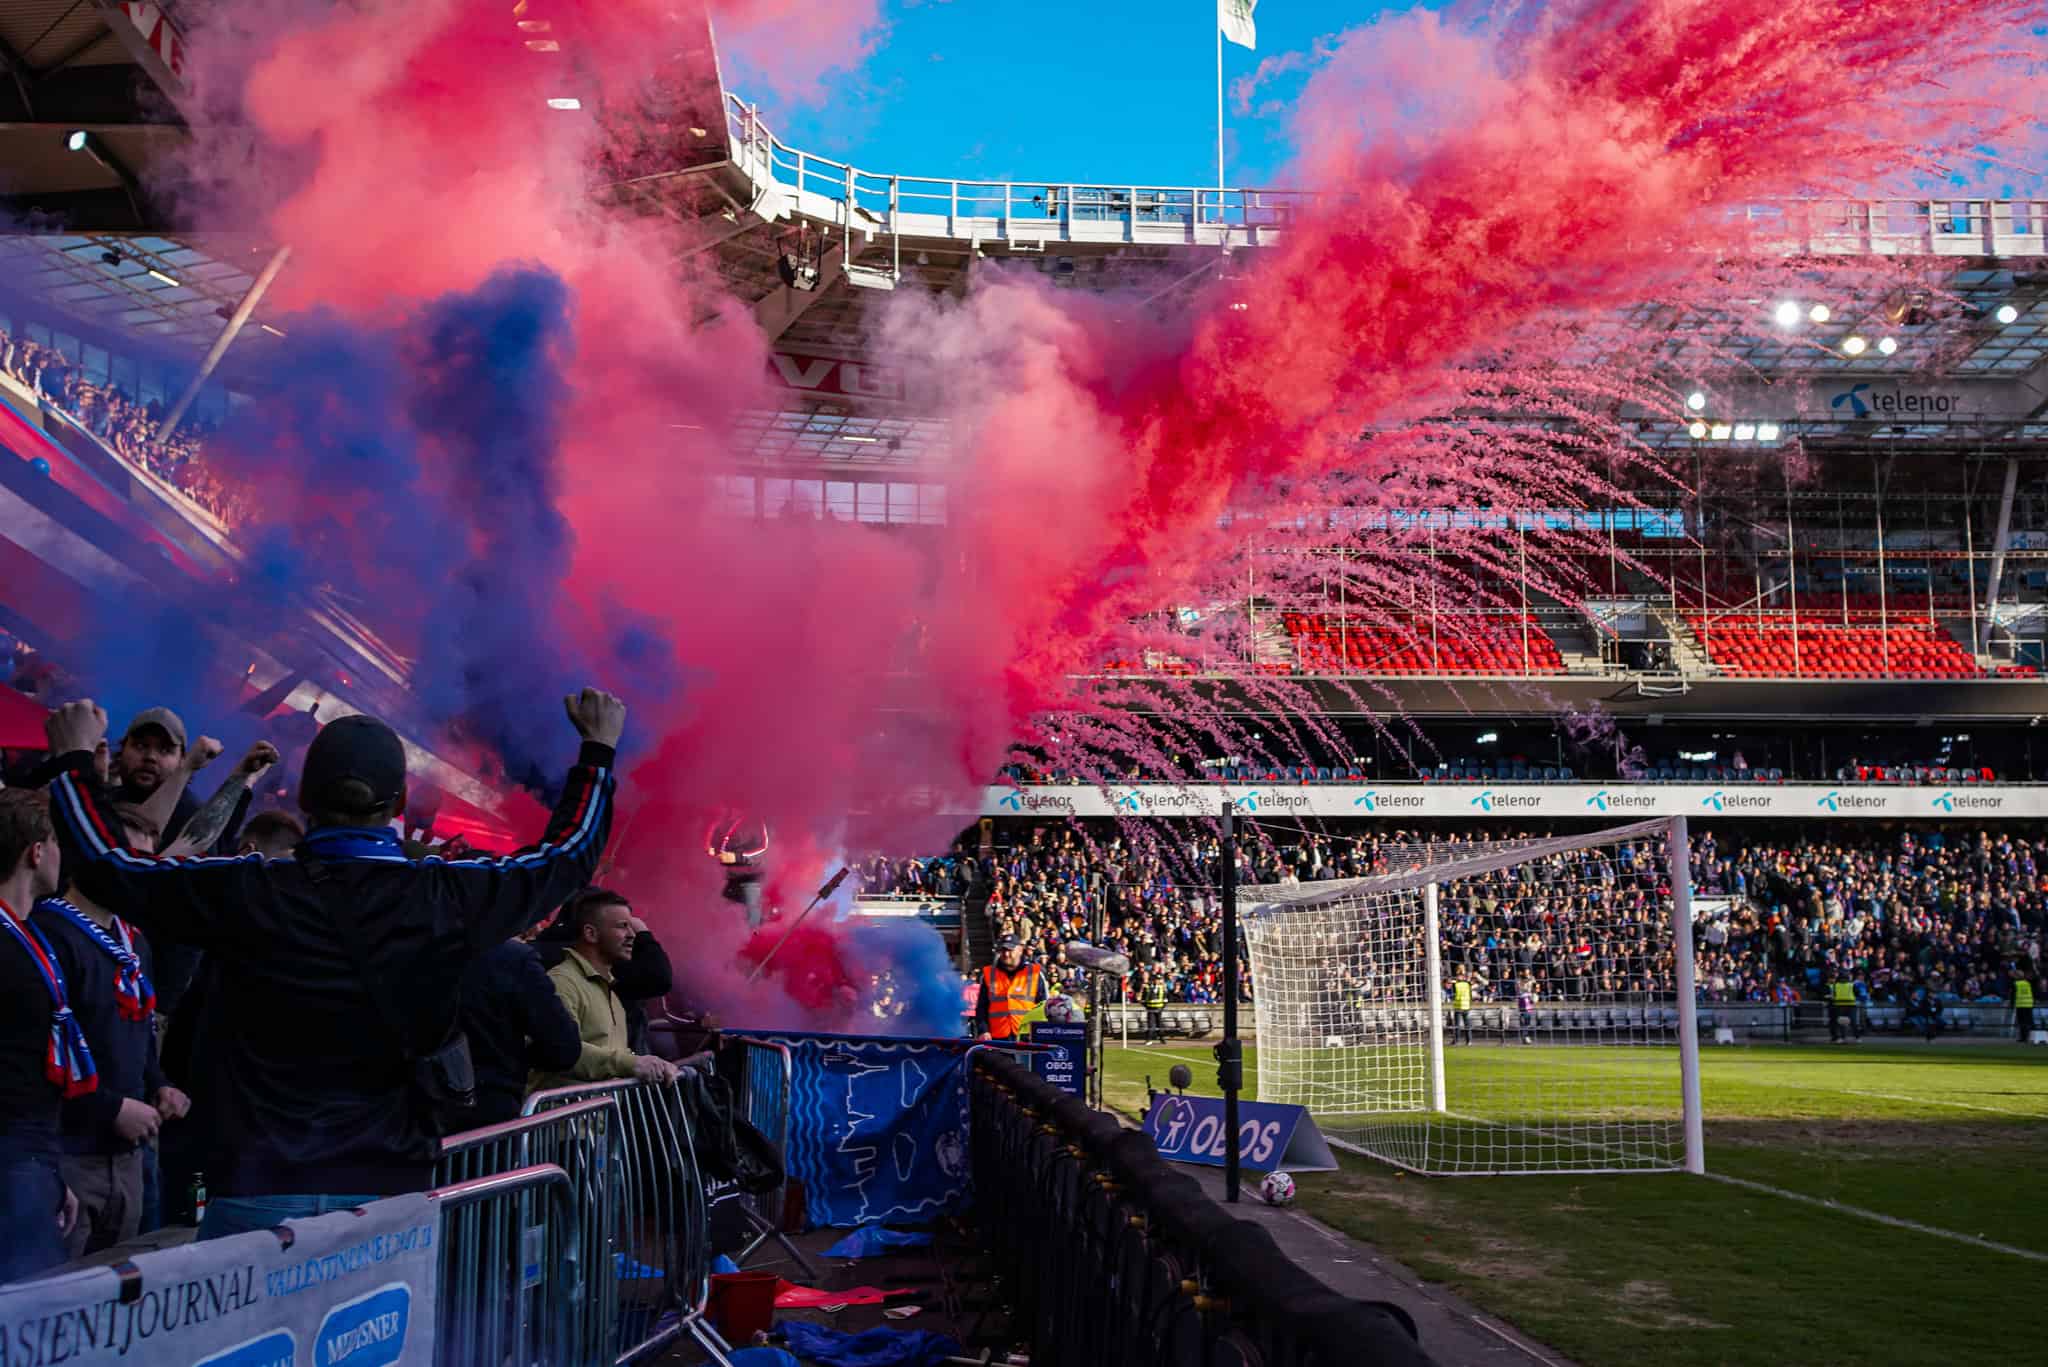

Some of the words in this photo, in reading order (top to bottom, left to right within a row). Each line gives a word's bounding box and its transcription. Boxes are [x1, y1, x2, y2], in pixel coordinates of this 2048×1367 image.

[1872, 390, 1960, 411] telenor
[1258, 794, 1309, 807] telenor
[1376, 794, 1425, 807] telenor
[1492, 794, 1541, 807] telenor
[1607, 794, 1656, 807] telenor
[1722, 794, 1772, 807] telenor
[1837, 794, 1887, 807] telenor
[1953, 794, 2004, 807] telenor
[1046, 1061, 1073, 1070] OBOS
